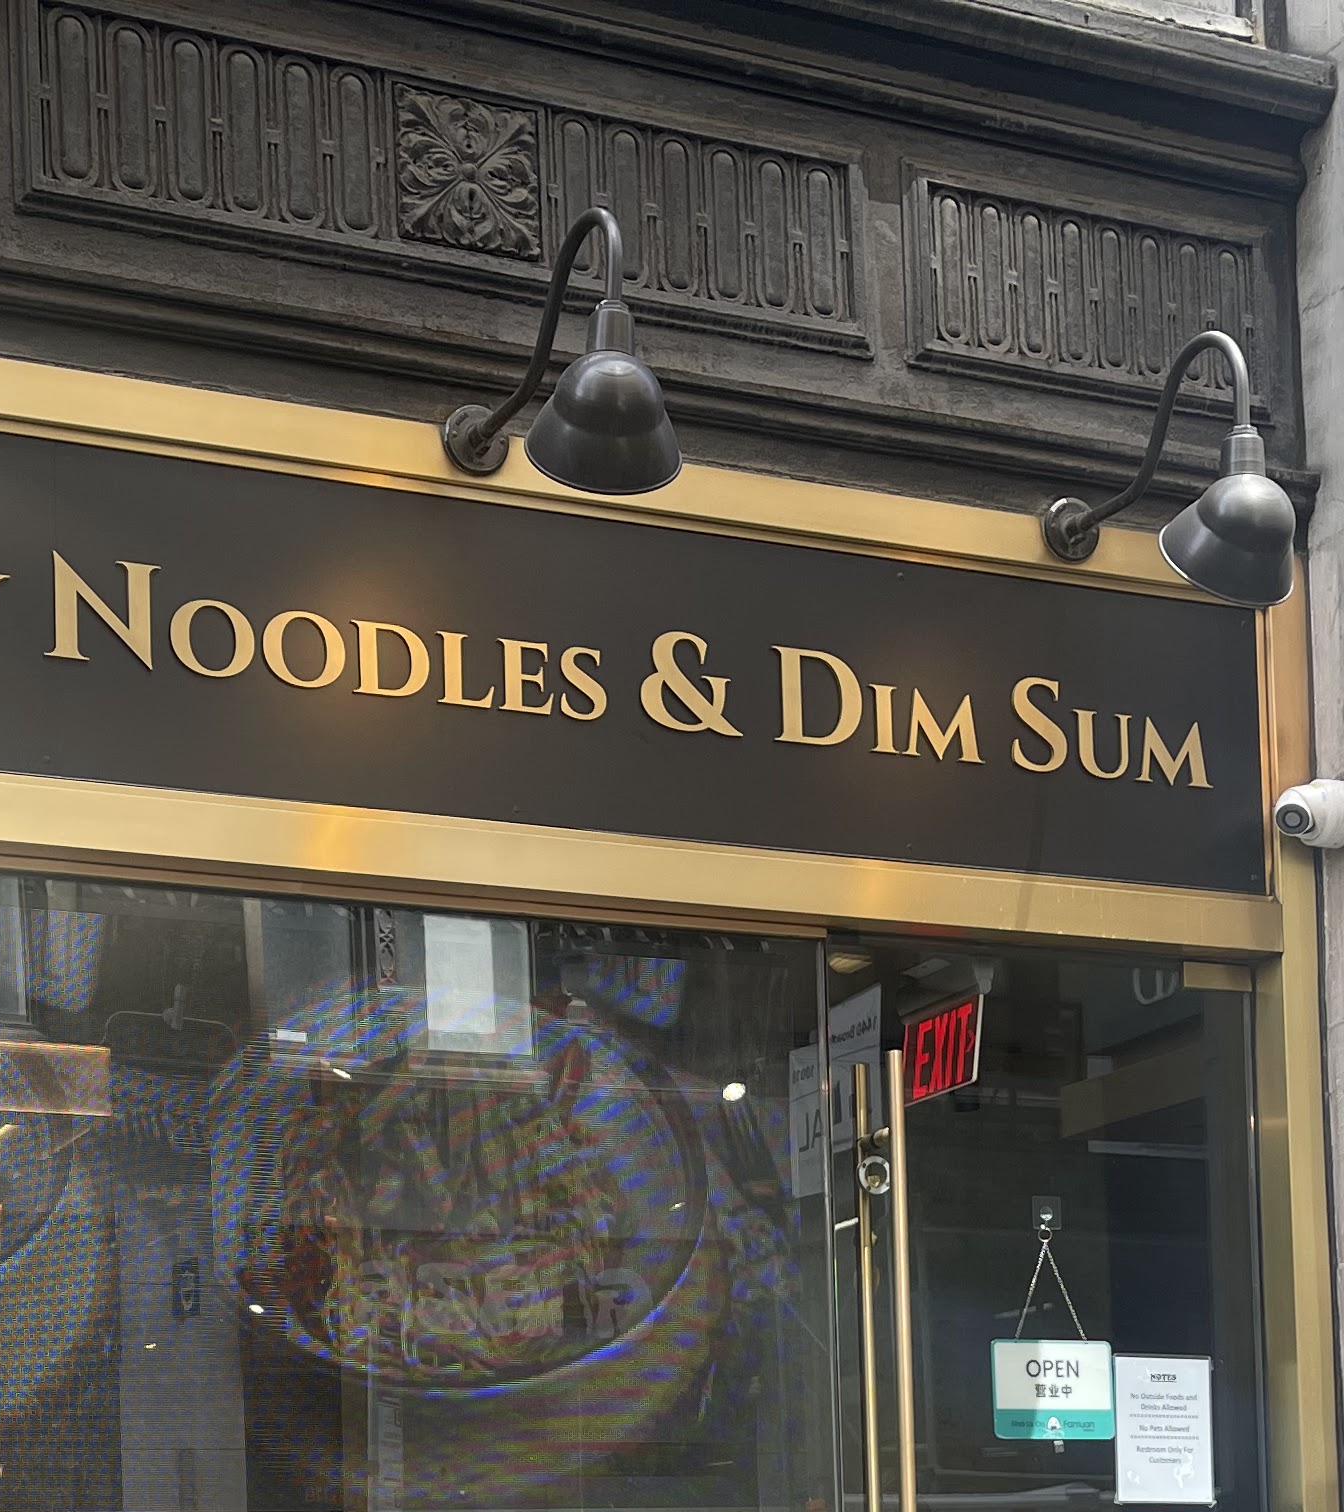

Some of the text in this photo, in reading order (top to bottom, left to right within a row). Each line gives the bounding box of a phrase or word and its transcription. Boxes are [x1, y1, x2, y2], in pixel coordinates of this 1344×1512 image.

[43, 550, 608, 721] NOODLES
[640, 630, 743, 738] &
[771, 644, 986, 766] DIM
[1010, 675, 1214, 790] SUM
[913, 1003, 974, 1101] EXIT
[1025, 1359, 1080, 1378] OPEN
